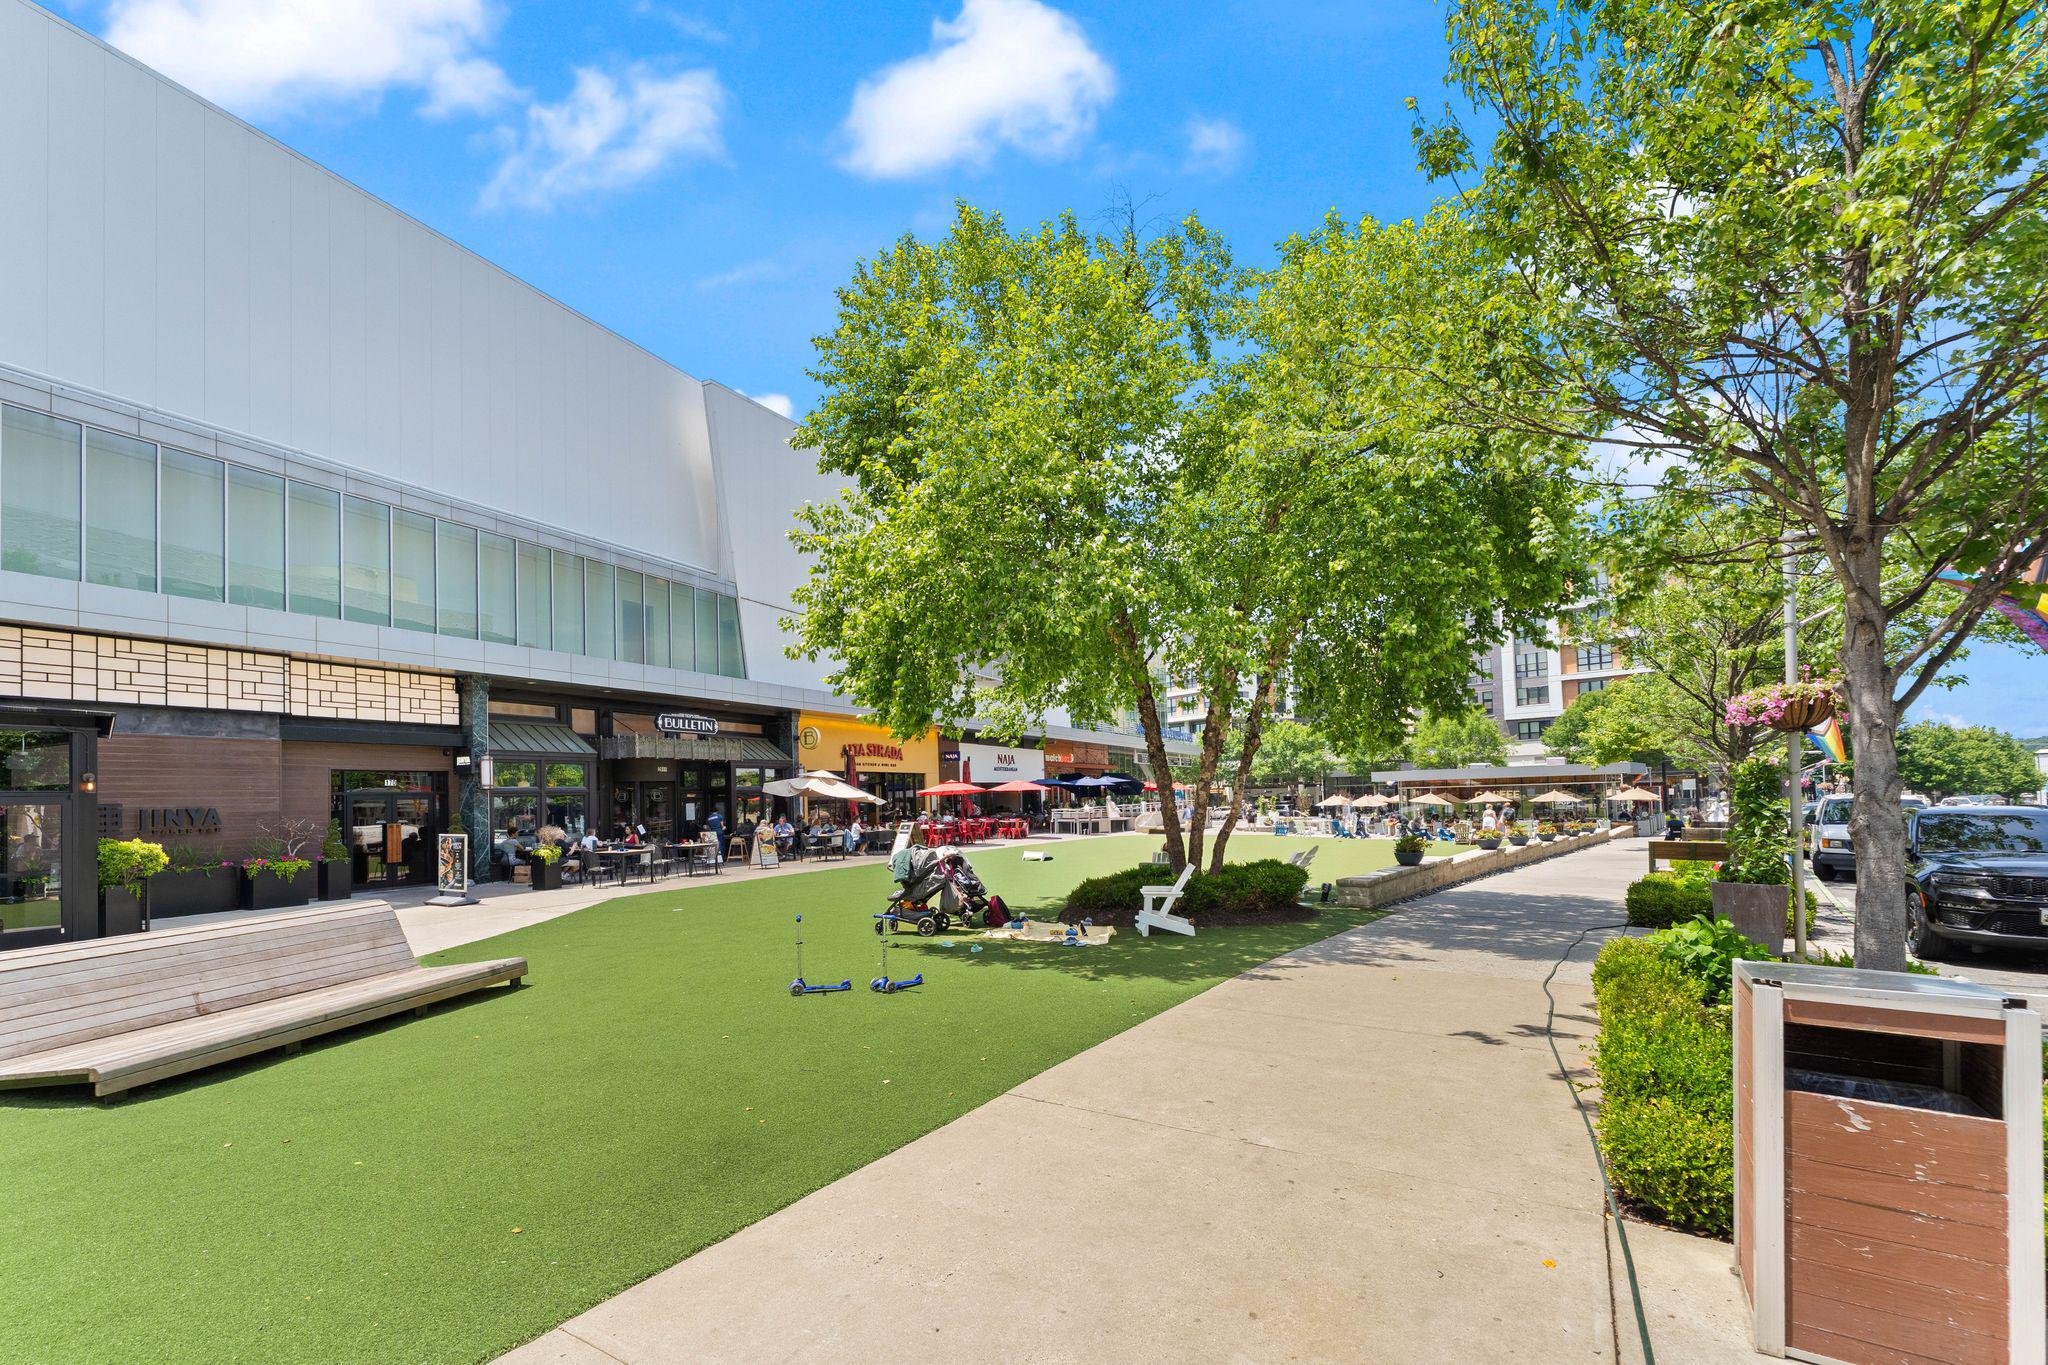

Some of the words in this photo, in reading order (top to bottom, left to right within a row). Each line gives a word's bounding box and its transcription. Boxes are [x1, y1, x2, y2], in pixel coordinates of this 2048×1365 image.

[664, 717, 713, 731] BULLETIN
[866, 743, 903, 761] STRADA
[997, 753, 1015, 766] NAJA
[138, 808, 222, 834] JINYA
